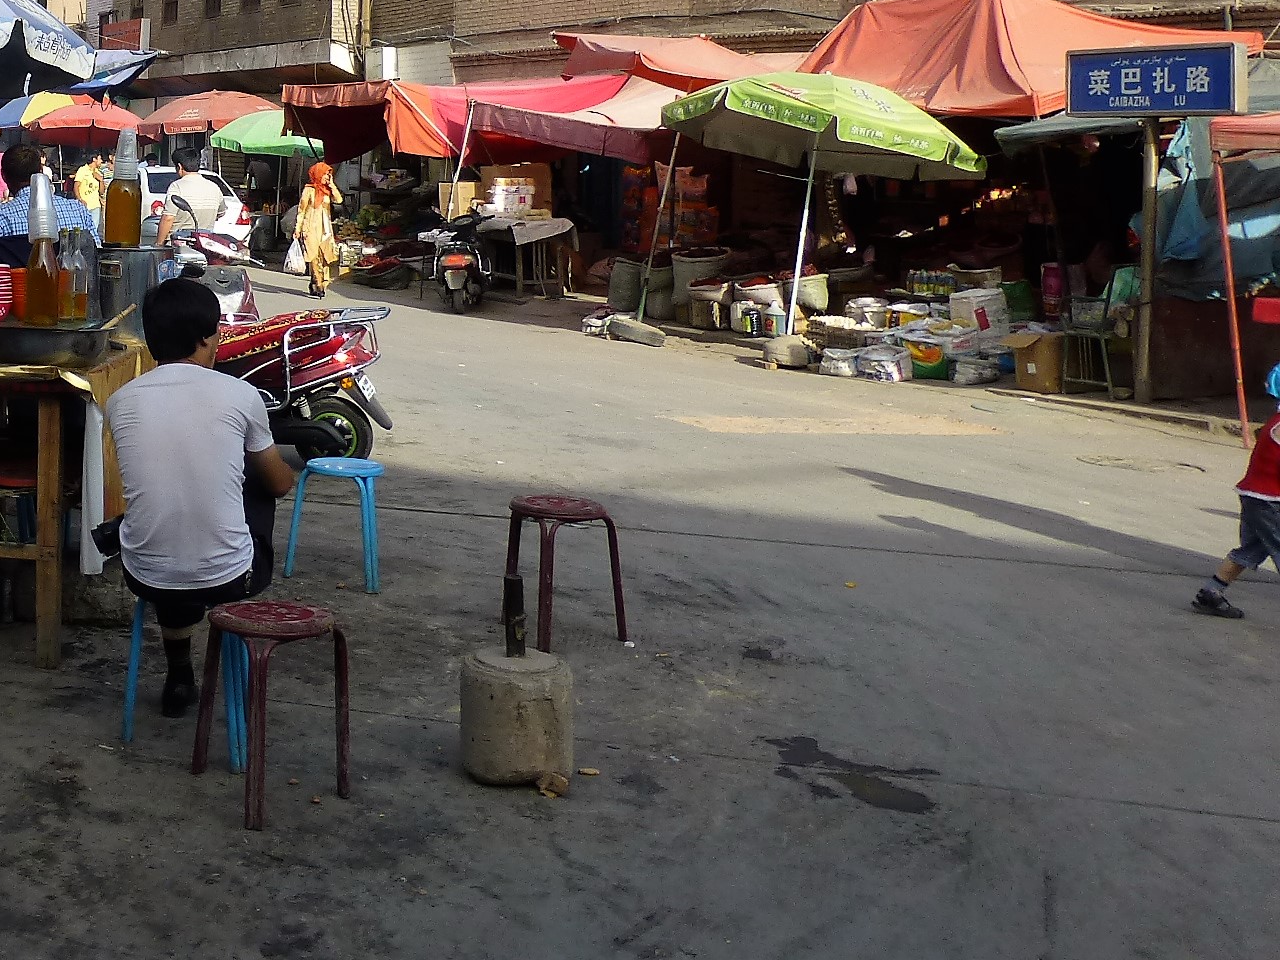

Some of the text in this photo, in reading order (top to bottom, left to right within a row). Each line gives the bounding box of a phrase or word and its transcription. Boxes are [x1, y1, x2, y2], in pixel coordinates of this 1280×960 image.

[1088, 66, 1210, 96] 菜巴扎路
[1109, 95, 1186, 107] CAIBAZHA LU
